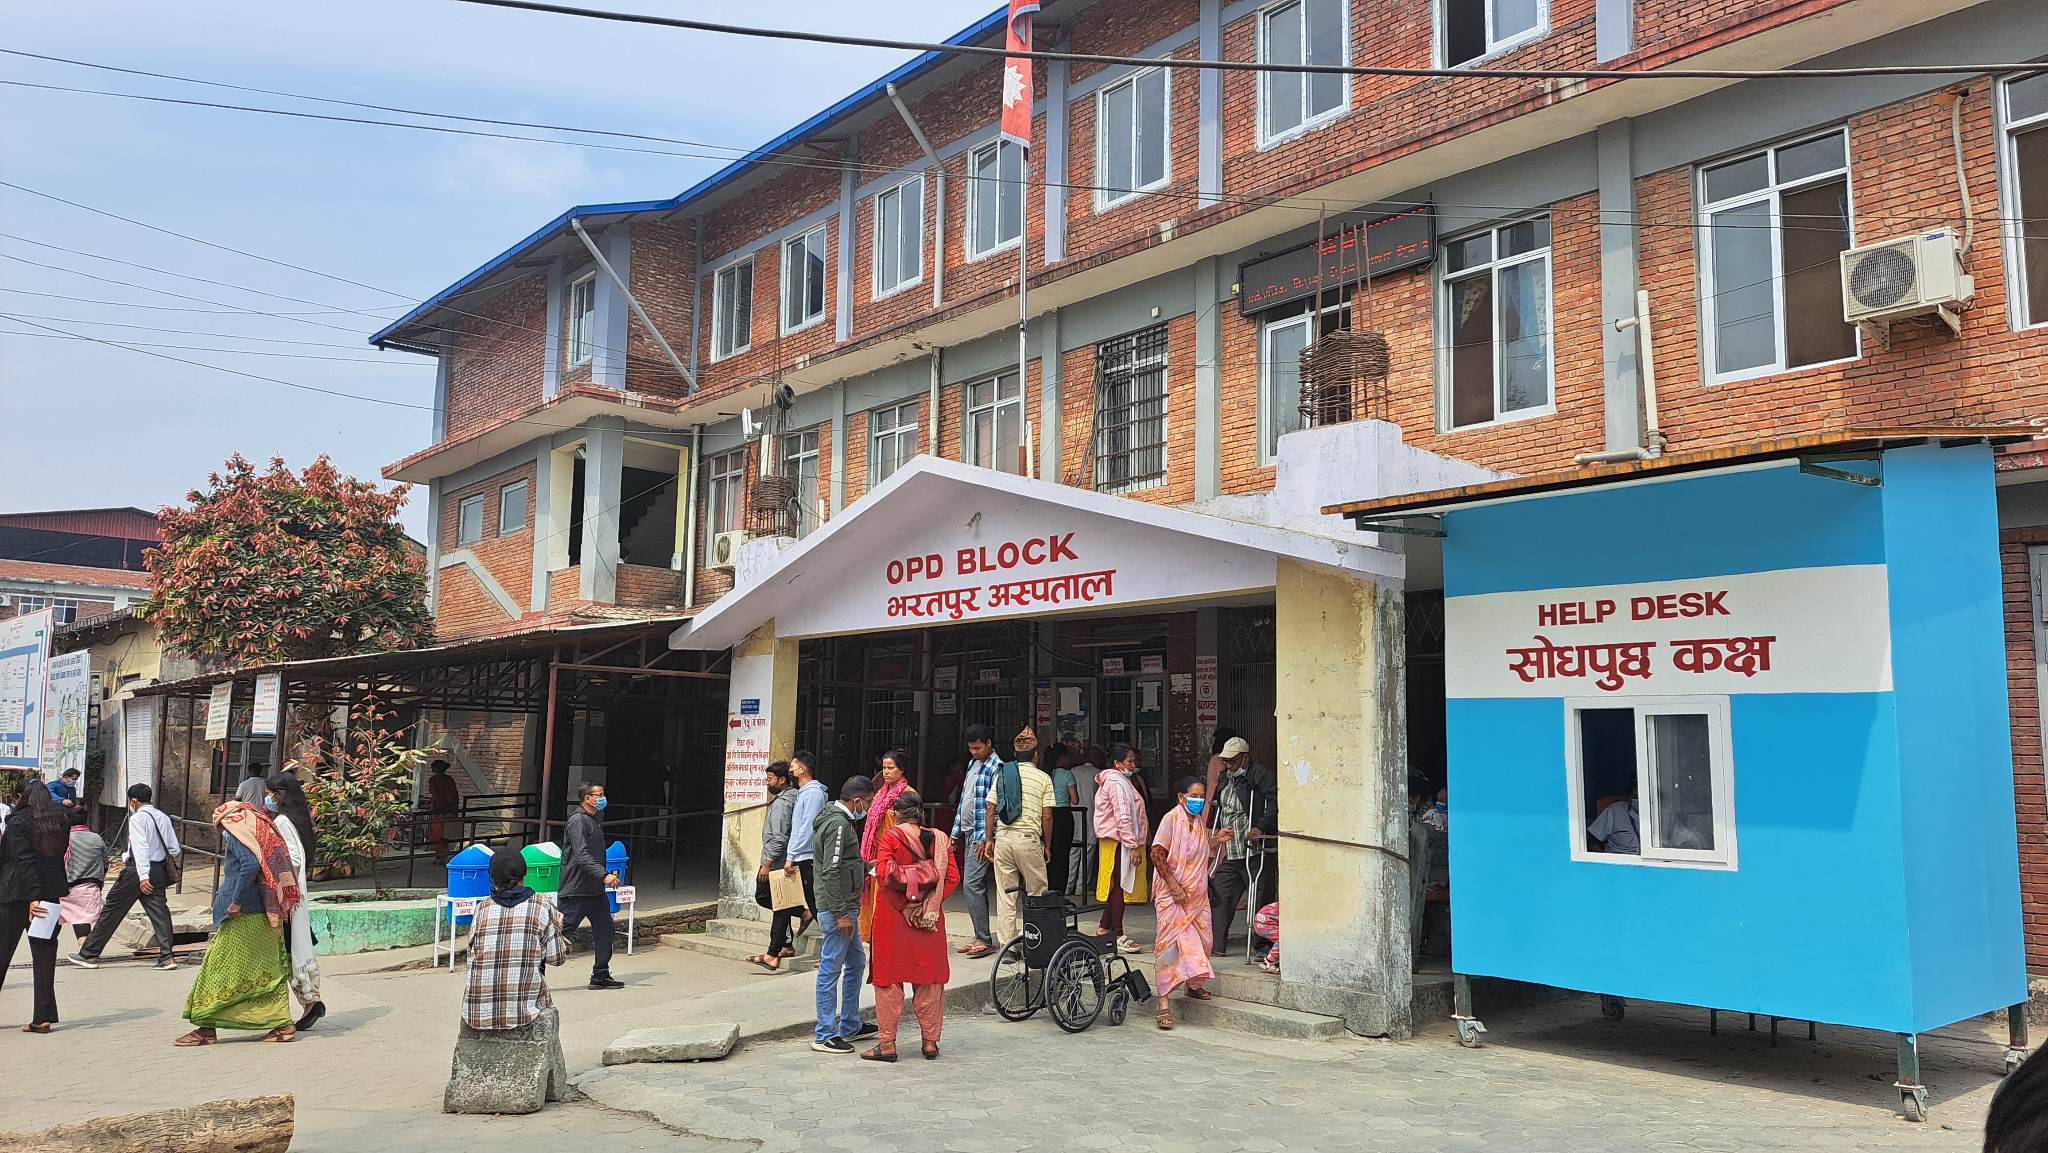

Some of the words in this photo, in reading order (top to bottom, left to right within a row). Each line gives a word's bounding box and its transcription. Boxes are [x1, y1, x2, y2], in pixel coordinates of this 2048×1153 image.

[886, 554, 943, 585] OPD
[957, 532, 1079, 575] BLOCK
[887, 586, 982, 620] भरतपुर
[987, 569, 1117, 608] अस्पताल
[1538, 599, 1617, 627] HELP
[1630, 590, 1731, 621] DESK
[1669, 635, 1777, 678] कक्ष
